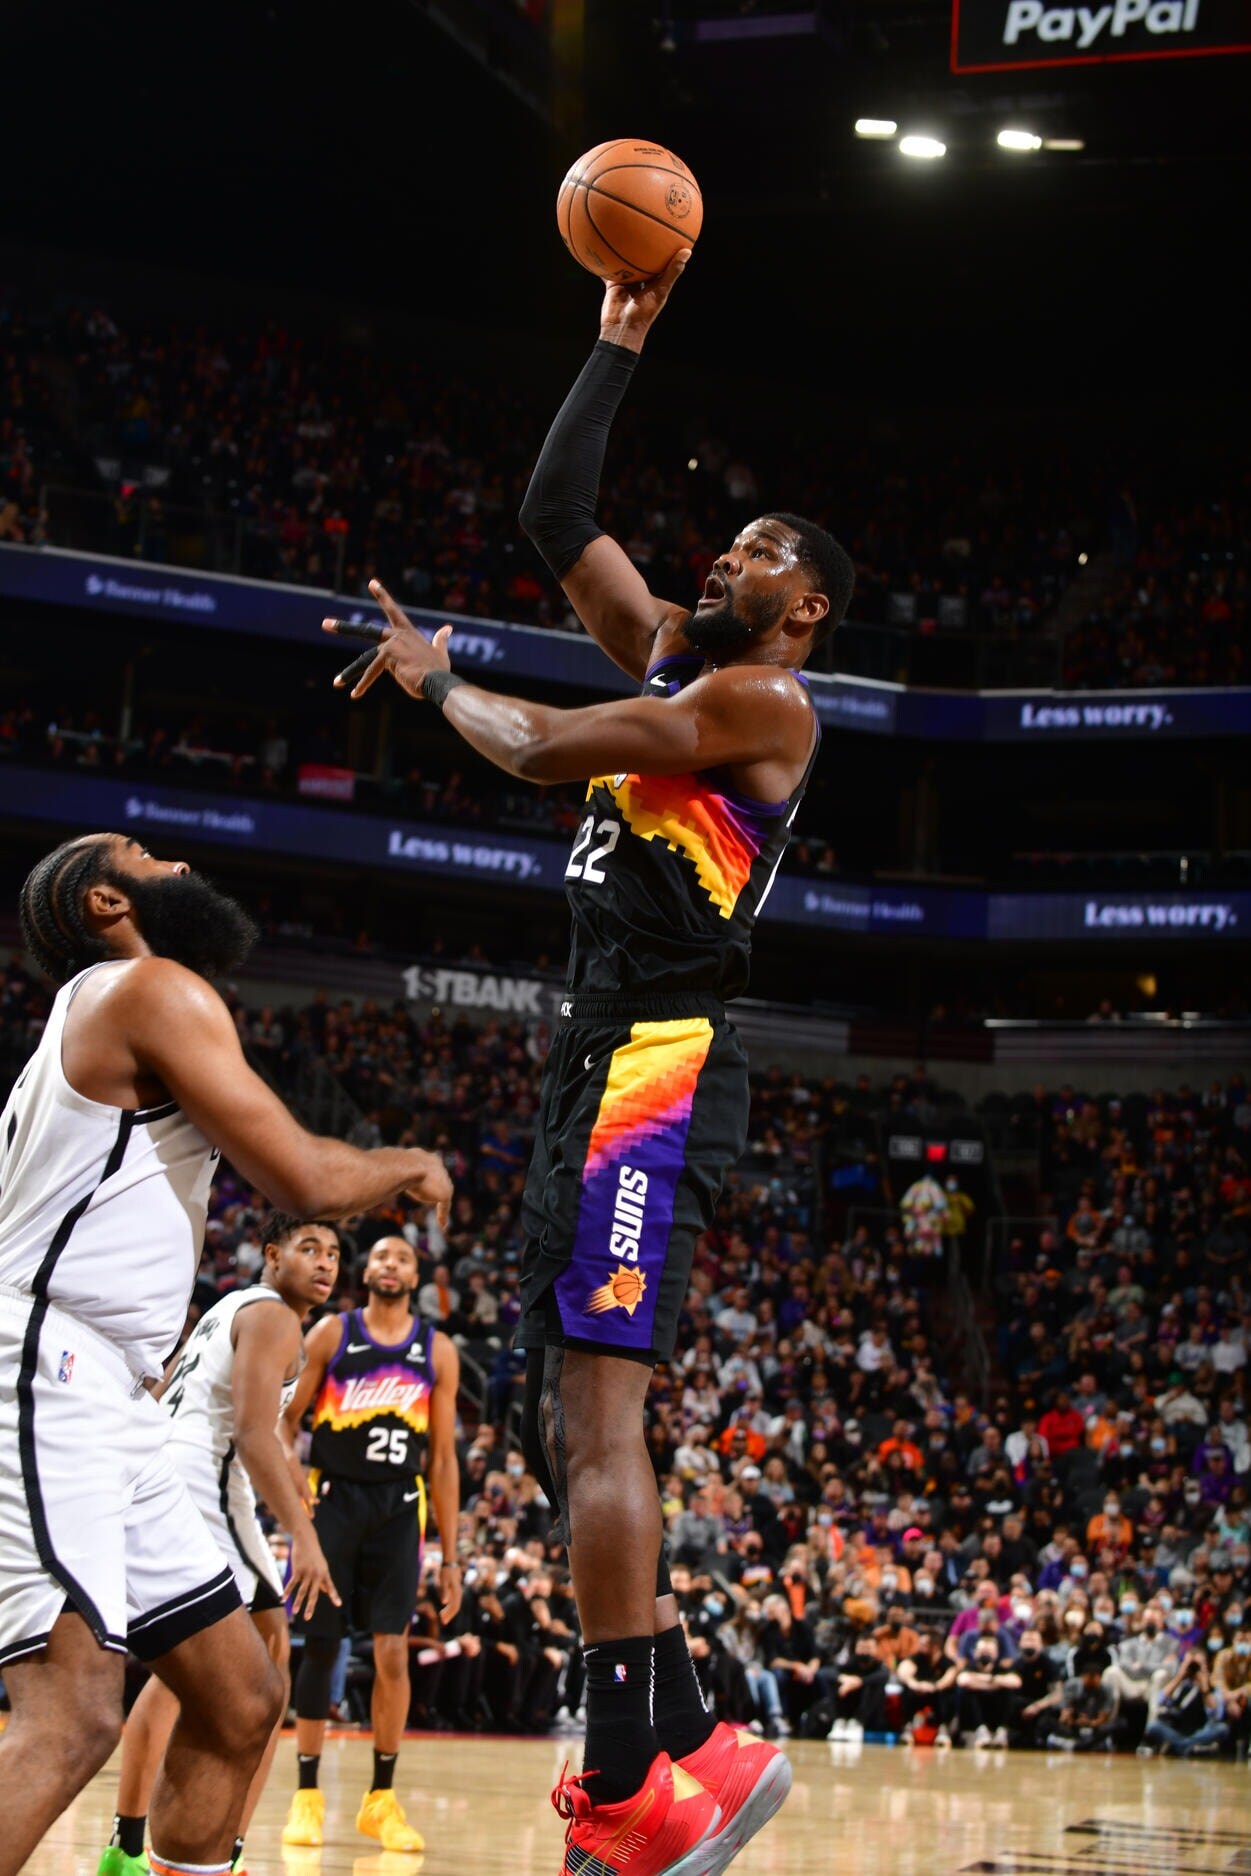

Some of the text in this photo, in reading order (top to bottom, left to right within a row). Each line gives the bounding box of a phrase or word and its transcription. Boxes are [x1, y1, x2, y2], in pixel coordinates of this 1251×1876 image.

[1003, 0, 1199, 48] PayPal
[1021, 703, 1174, 731] Less worry.
[388, 830, 542, 879] Less worry.
[564, 814, 621, 884] 22
[1084, 901, 1239, 931] Less worry.
[609, 1165, 648, 1262] SUNS
[340, 1375, 425, 1412] Valley
[366, 1426, 409, 1465] 25
